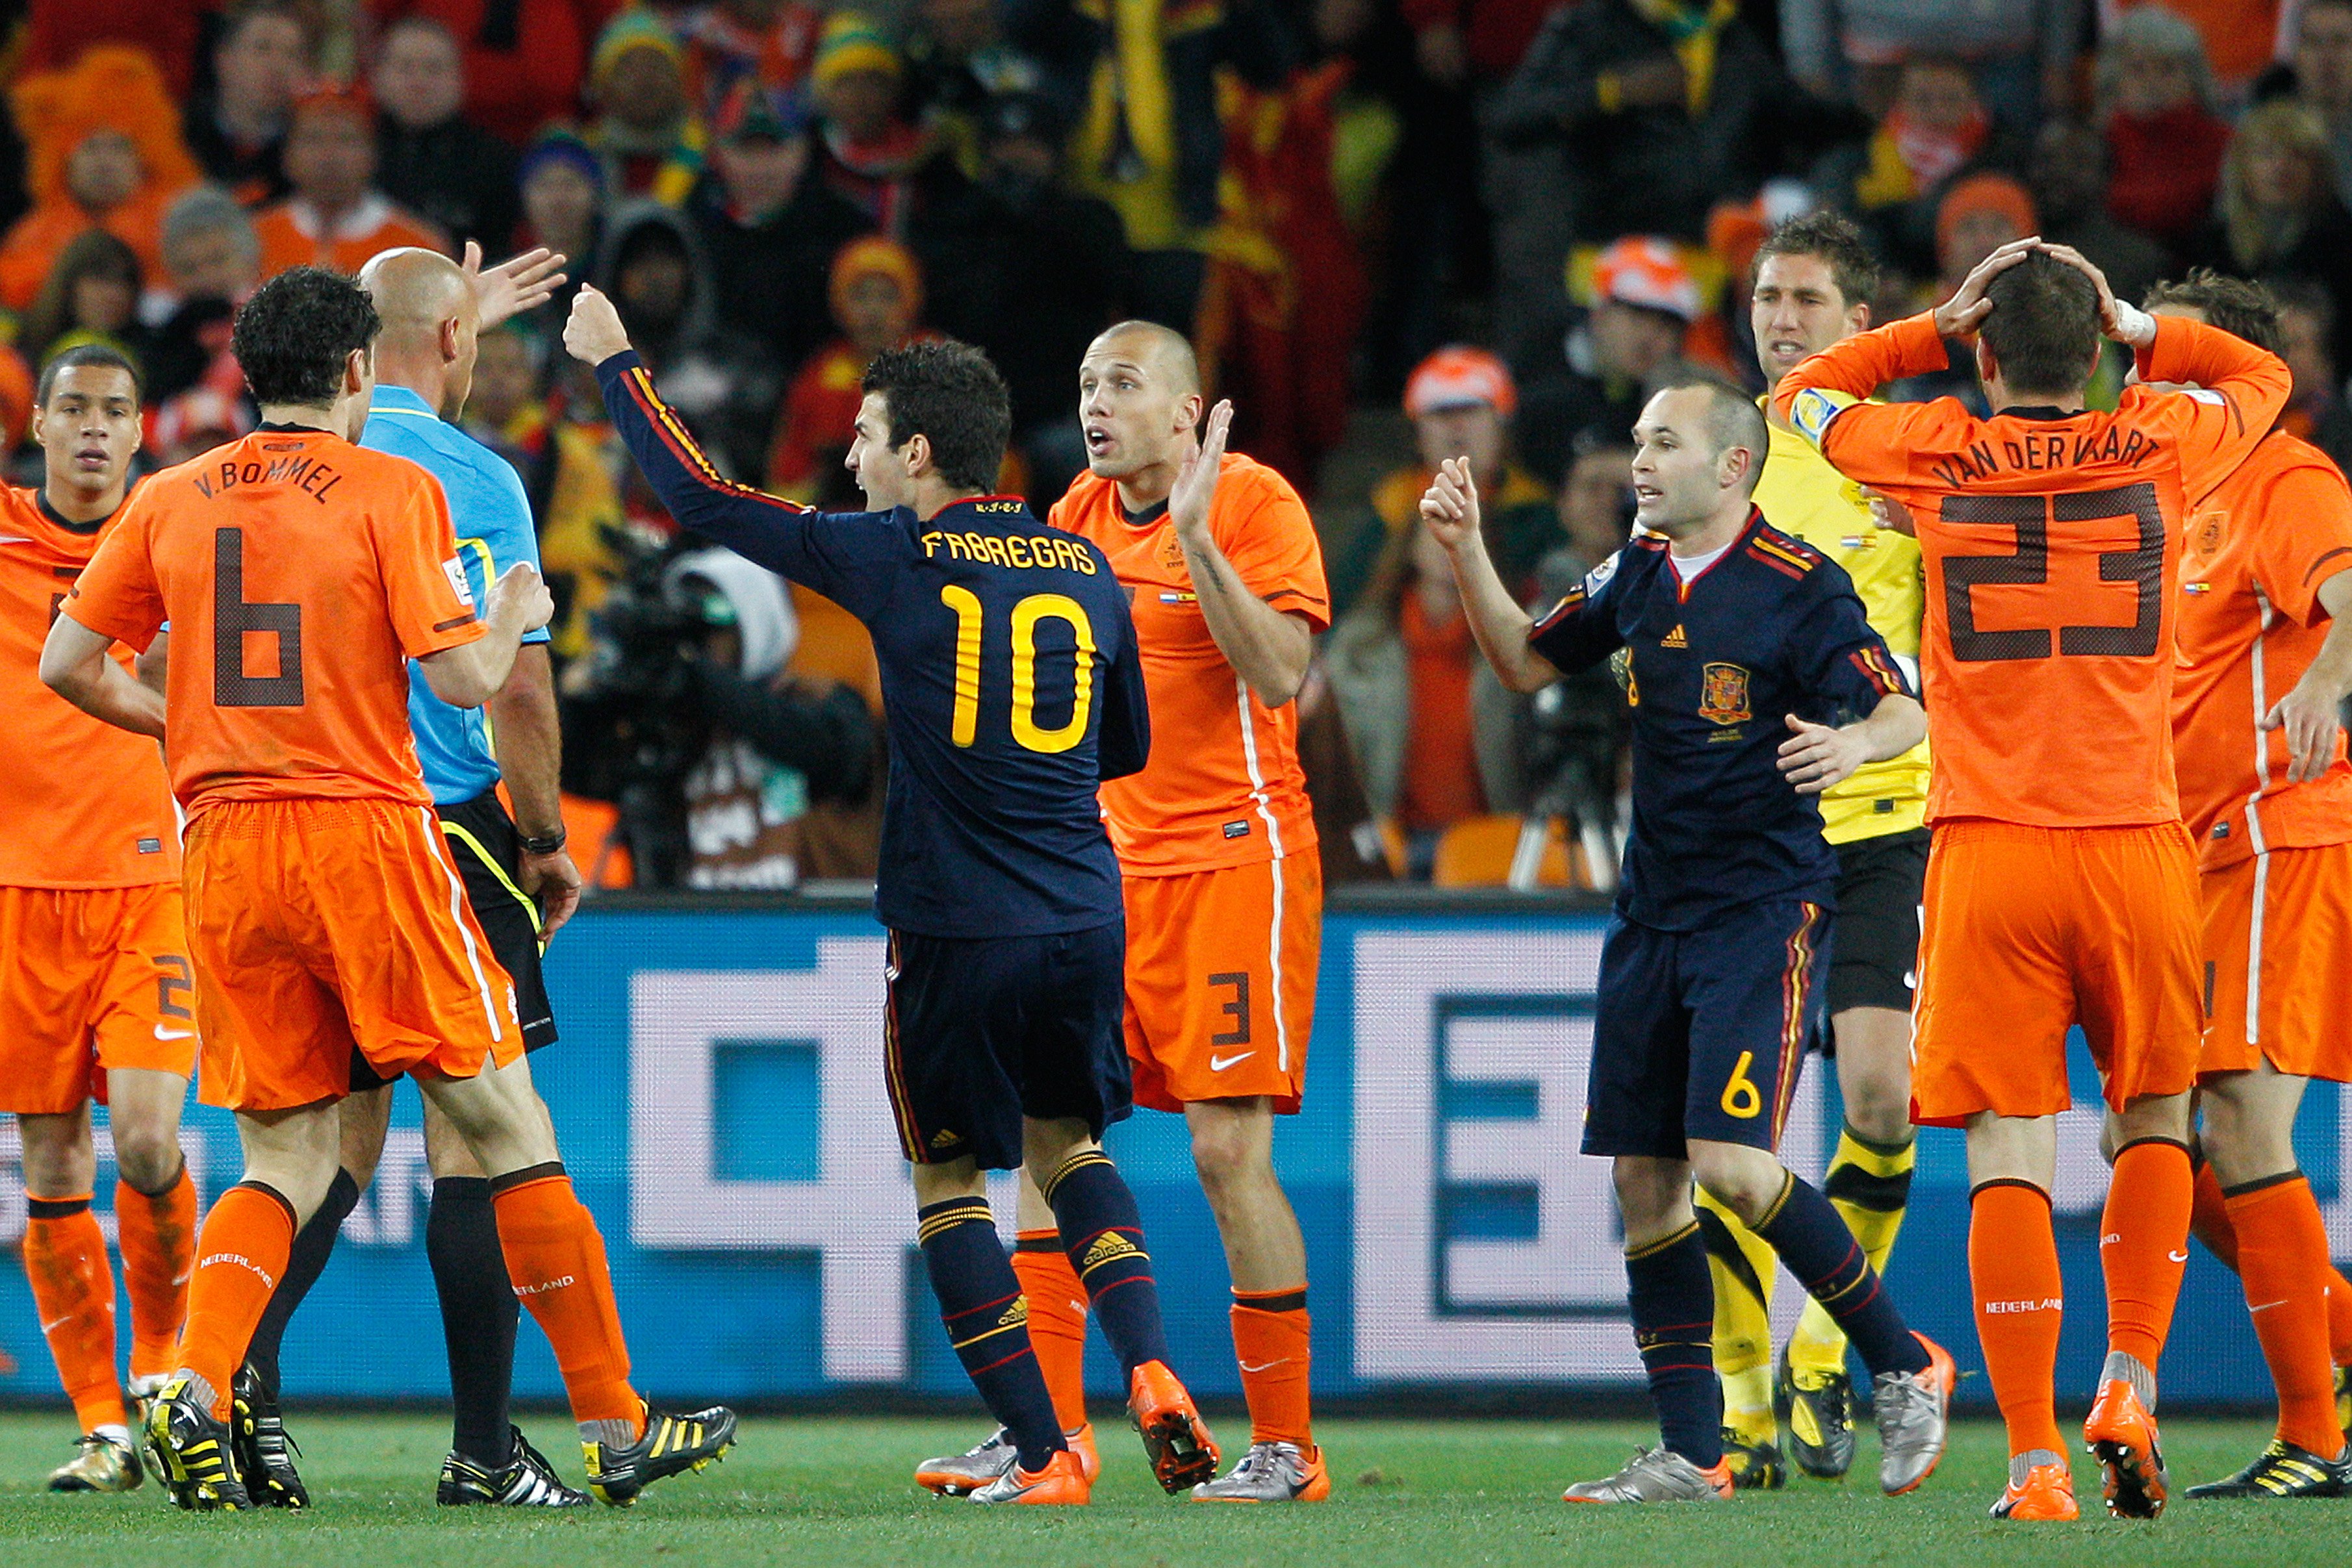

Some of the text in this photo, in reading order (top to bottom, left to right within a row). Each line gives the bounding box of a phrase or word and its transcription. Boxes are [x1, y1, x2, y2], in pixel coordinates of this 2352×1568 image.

[193, 455, 342, 505] V.BOMMEL
[1932, 440, 1999, 489] VAN
[2003, 435, 2066, 471] DER
[921, 530, 1097, 575] FABREGAS
[1940, 482, 2166, 662] 23
[214, 527, 304, 707] 6
[940, 583, 1096, 753] 10
[151, 955, 192, 1020] 2
[1208, 972, 1249, 1046] 3
[1720, 1050, 1761, 1119] 6
[200, 1253, 273, 1289] NEDERLAND
[1082, 1241, 1137, 1265] adidas
[1986, 1298, 2064, 1313] NEDERLAND
